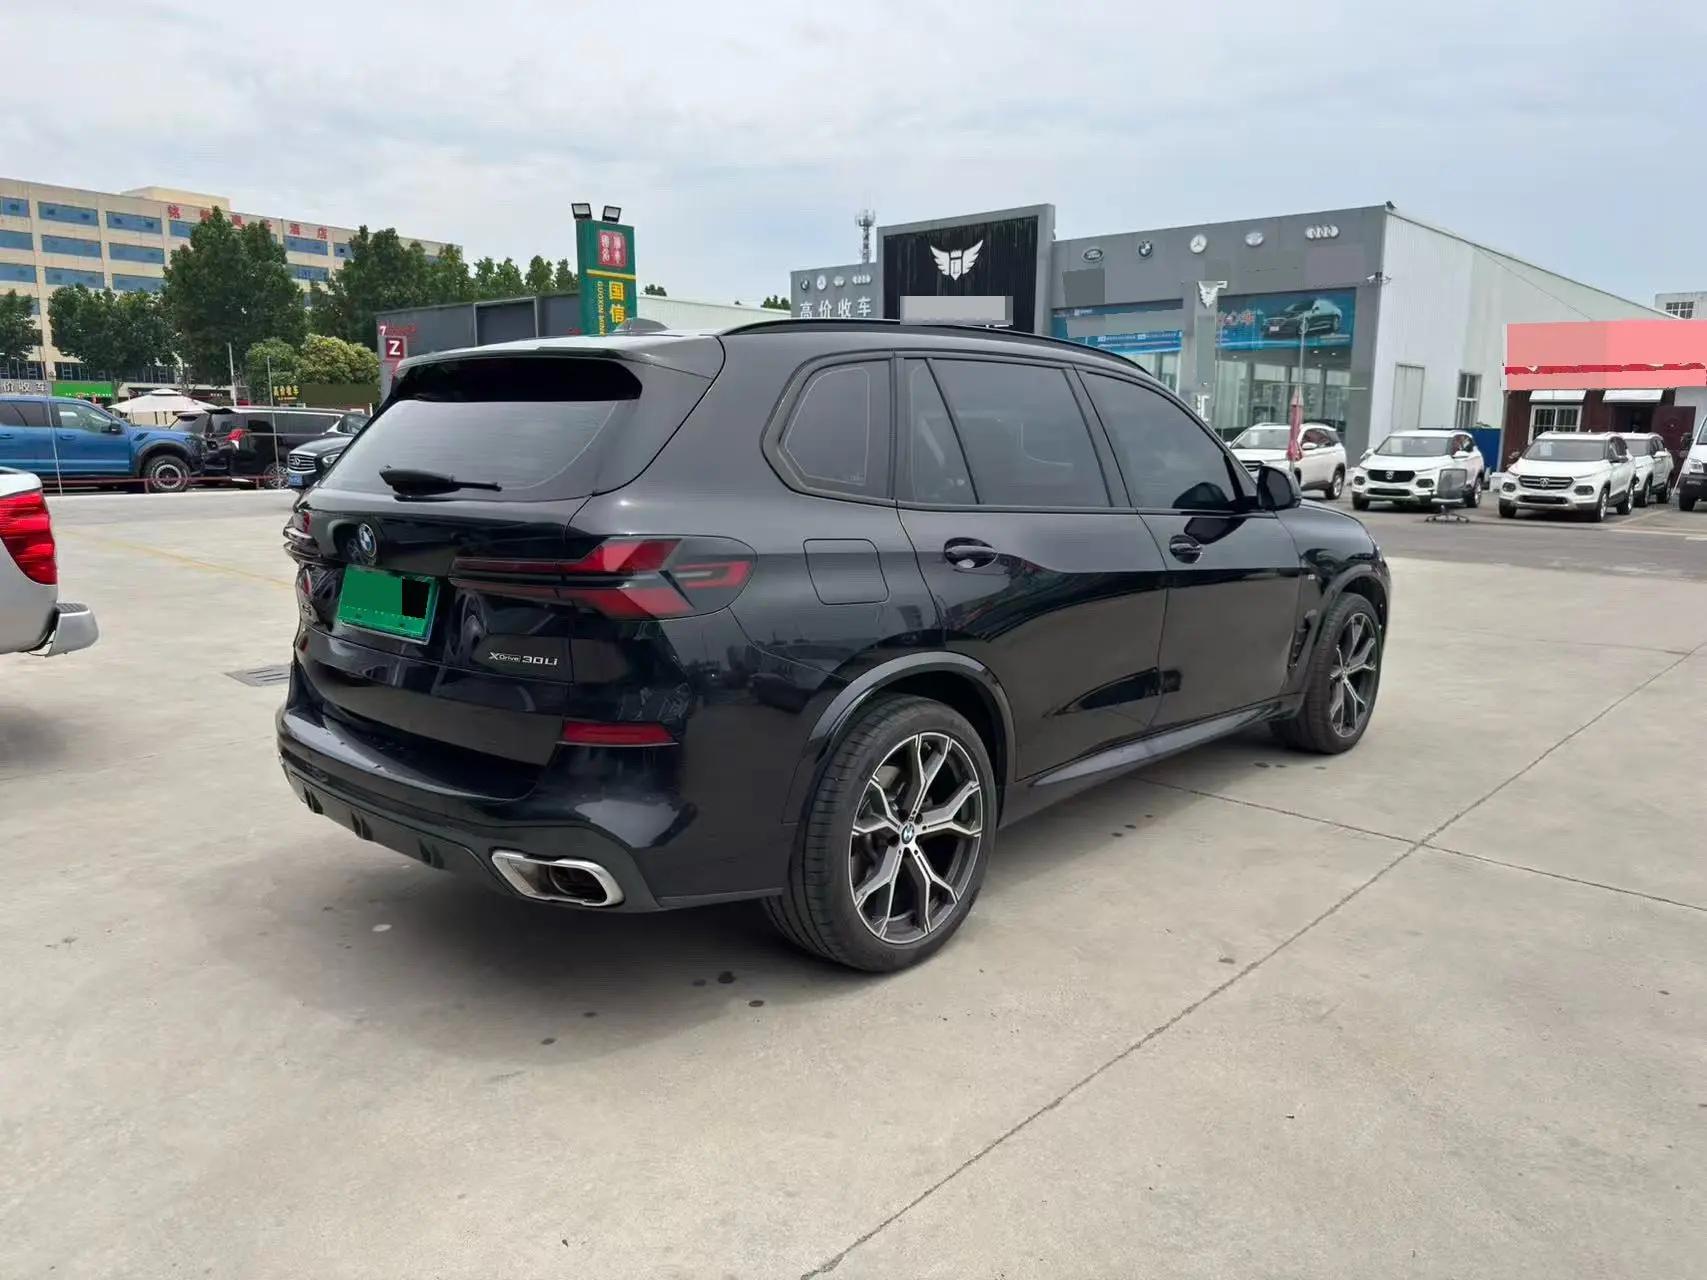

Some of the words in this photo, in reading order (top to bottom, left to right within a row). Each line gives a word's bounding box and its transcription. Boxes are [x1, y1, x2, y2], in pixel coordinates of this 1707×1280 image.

[609, 281, 625, 323] 国信
[800, 296, 872, 319] 高价收车
[389, 340, 401, 356] Z
